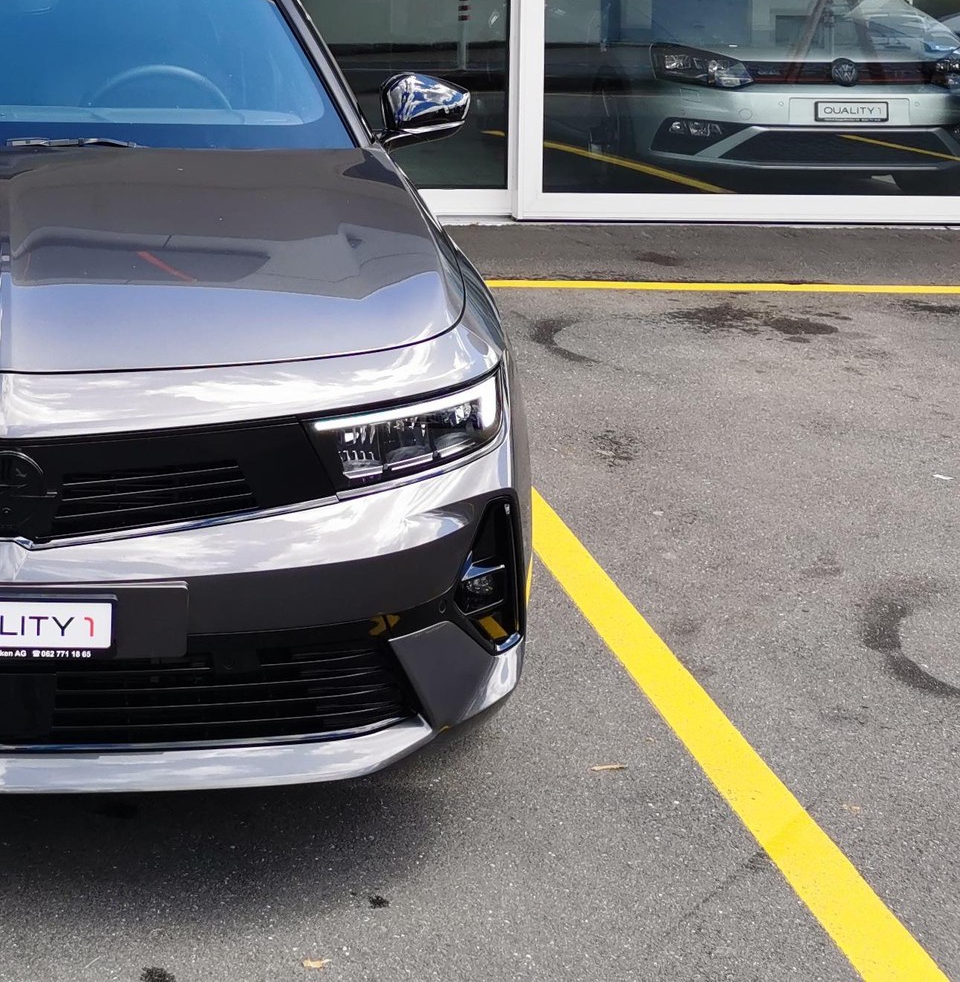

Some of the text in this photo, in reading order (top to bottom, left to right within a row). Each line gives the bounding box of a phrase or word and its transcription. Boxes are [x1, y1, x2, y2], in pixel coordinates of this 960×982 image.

[823, 106, 875, 115] QUALITY
[84, 616, 95, 637] 1
[14, 649, 27, 657] AG
[56, 650, 69, 658] 771
[71, 650, 81, 658] 18
